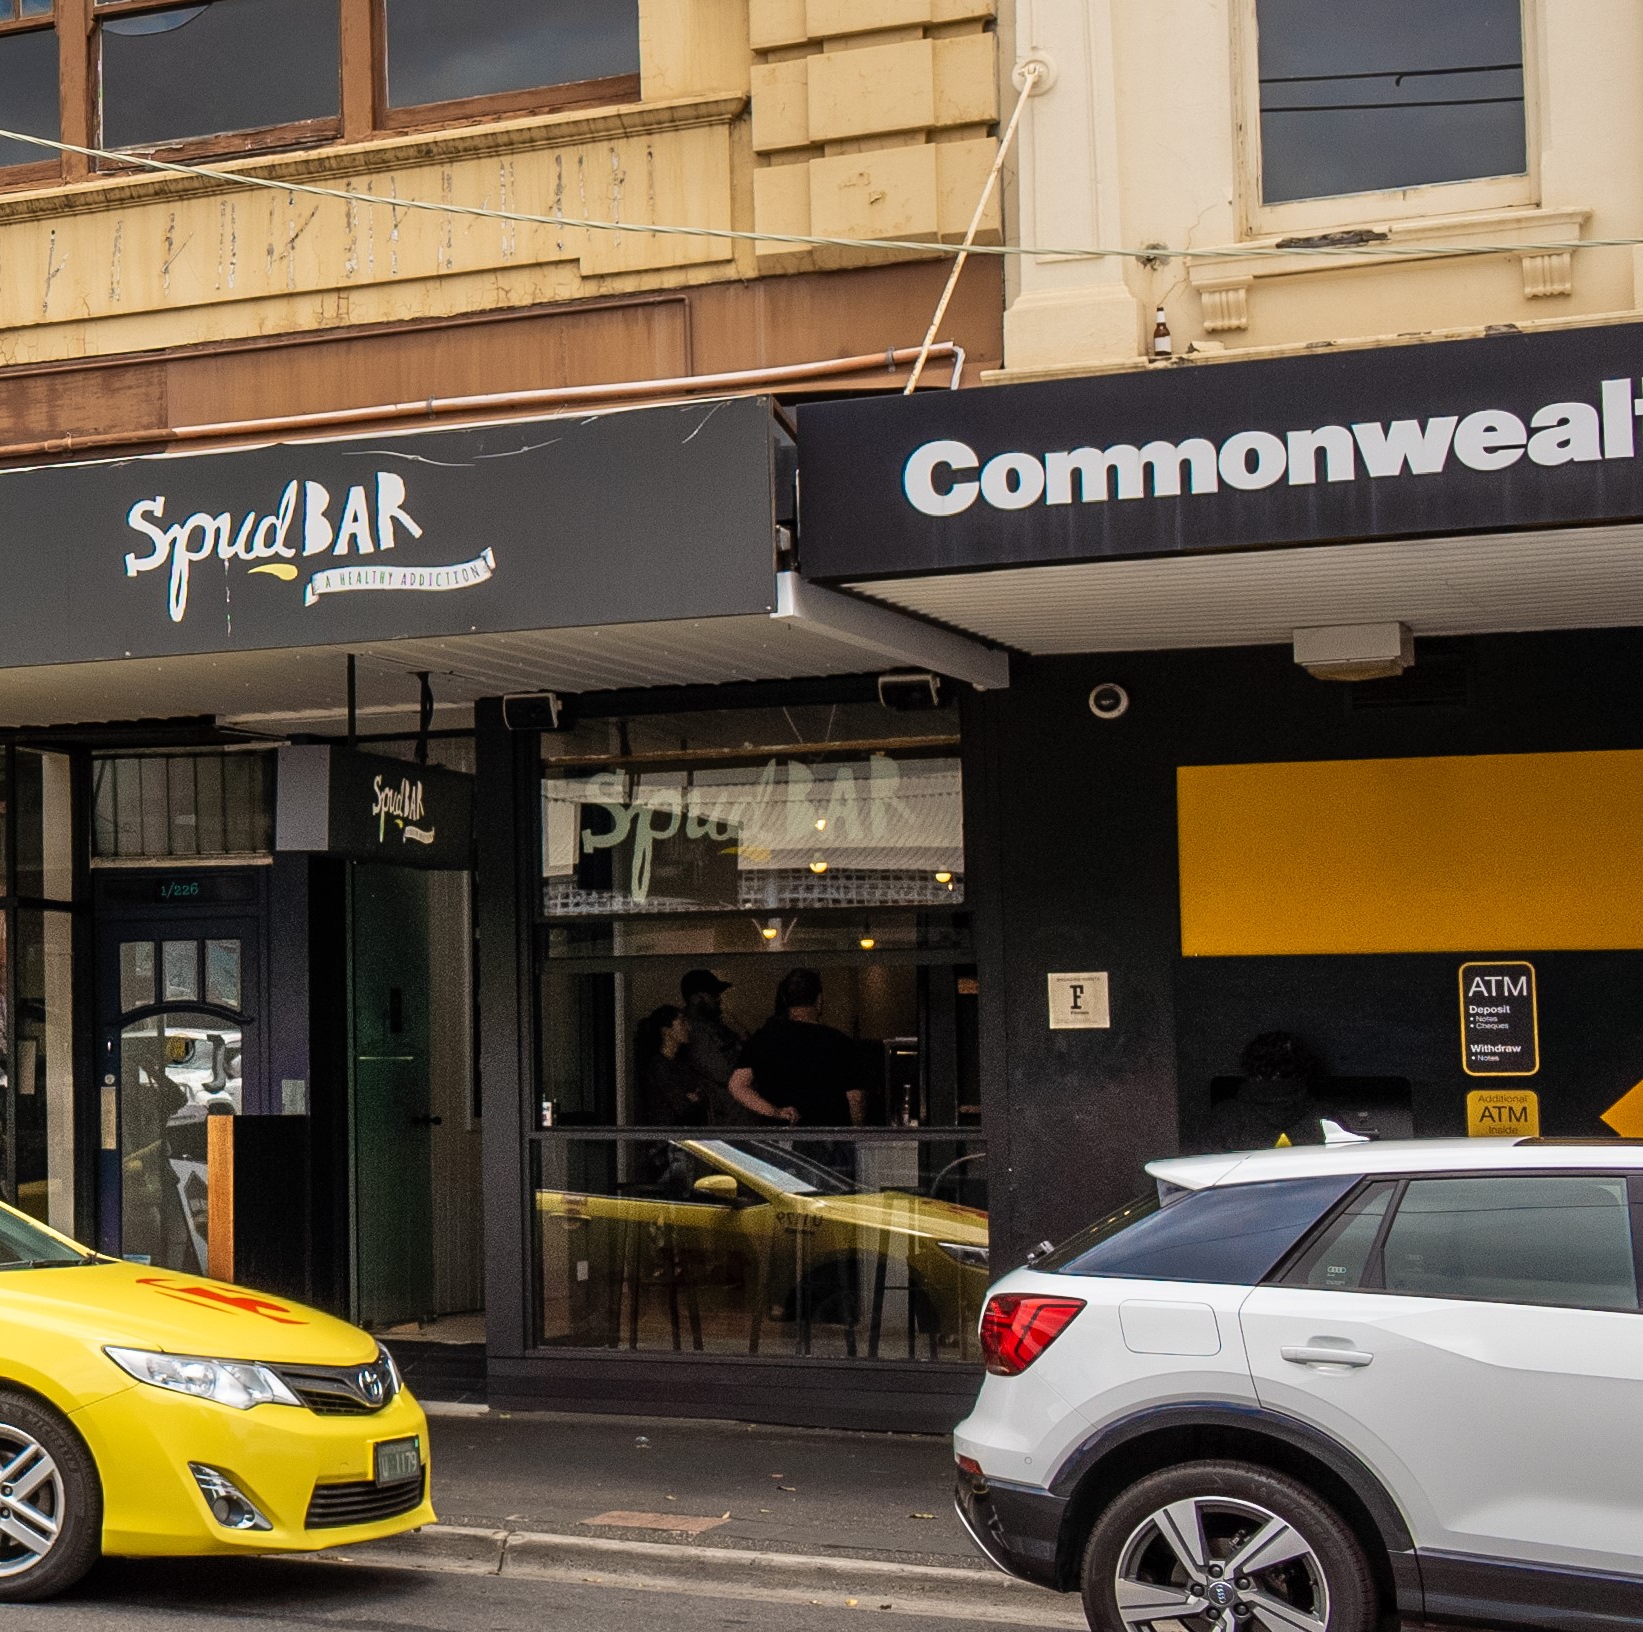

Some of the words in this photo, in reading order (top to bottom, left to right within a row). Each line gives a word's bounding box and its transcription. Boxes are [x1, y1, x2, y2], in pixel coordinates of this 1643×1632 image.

[325, 575, 332, 588] A
[339, 571, 394, 587] HEALTHY
[401, 563, 479, 587] ADDICTION
[161, 881, 199, 897] 1/226
[1468, 976, 1527, 996] ATM
[1069, 985, 1084, 1009] F
[1469, 1005, 1510, 1015] Deposit
[1470, 1044, 1522, 1053] Withdraw
[1478, 1094, 1527, 1103] Additional
[1479, 1106, 1528, 1123] ATM
[1488, 1126, 1518, 1135] Inside
